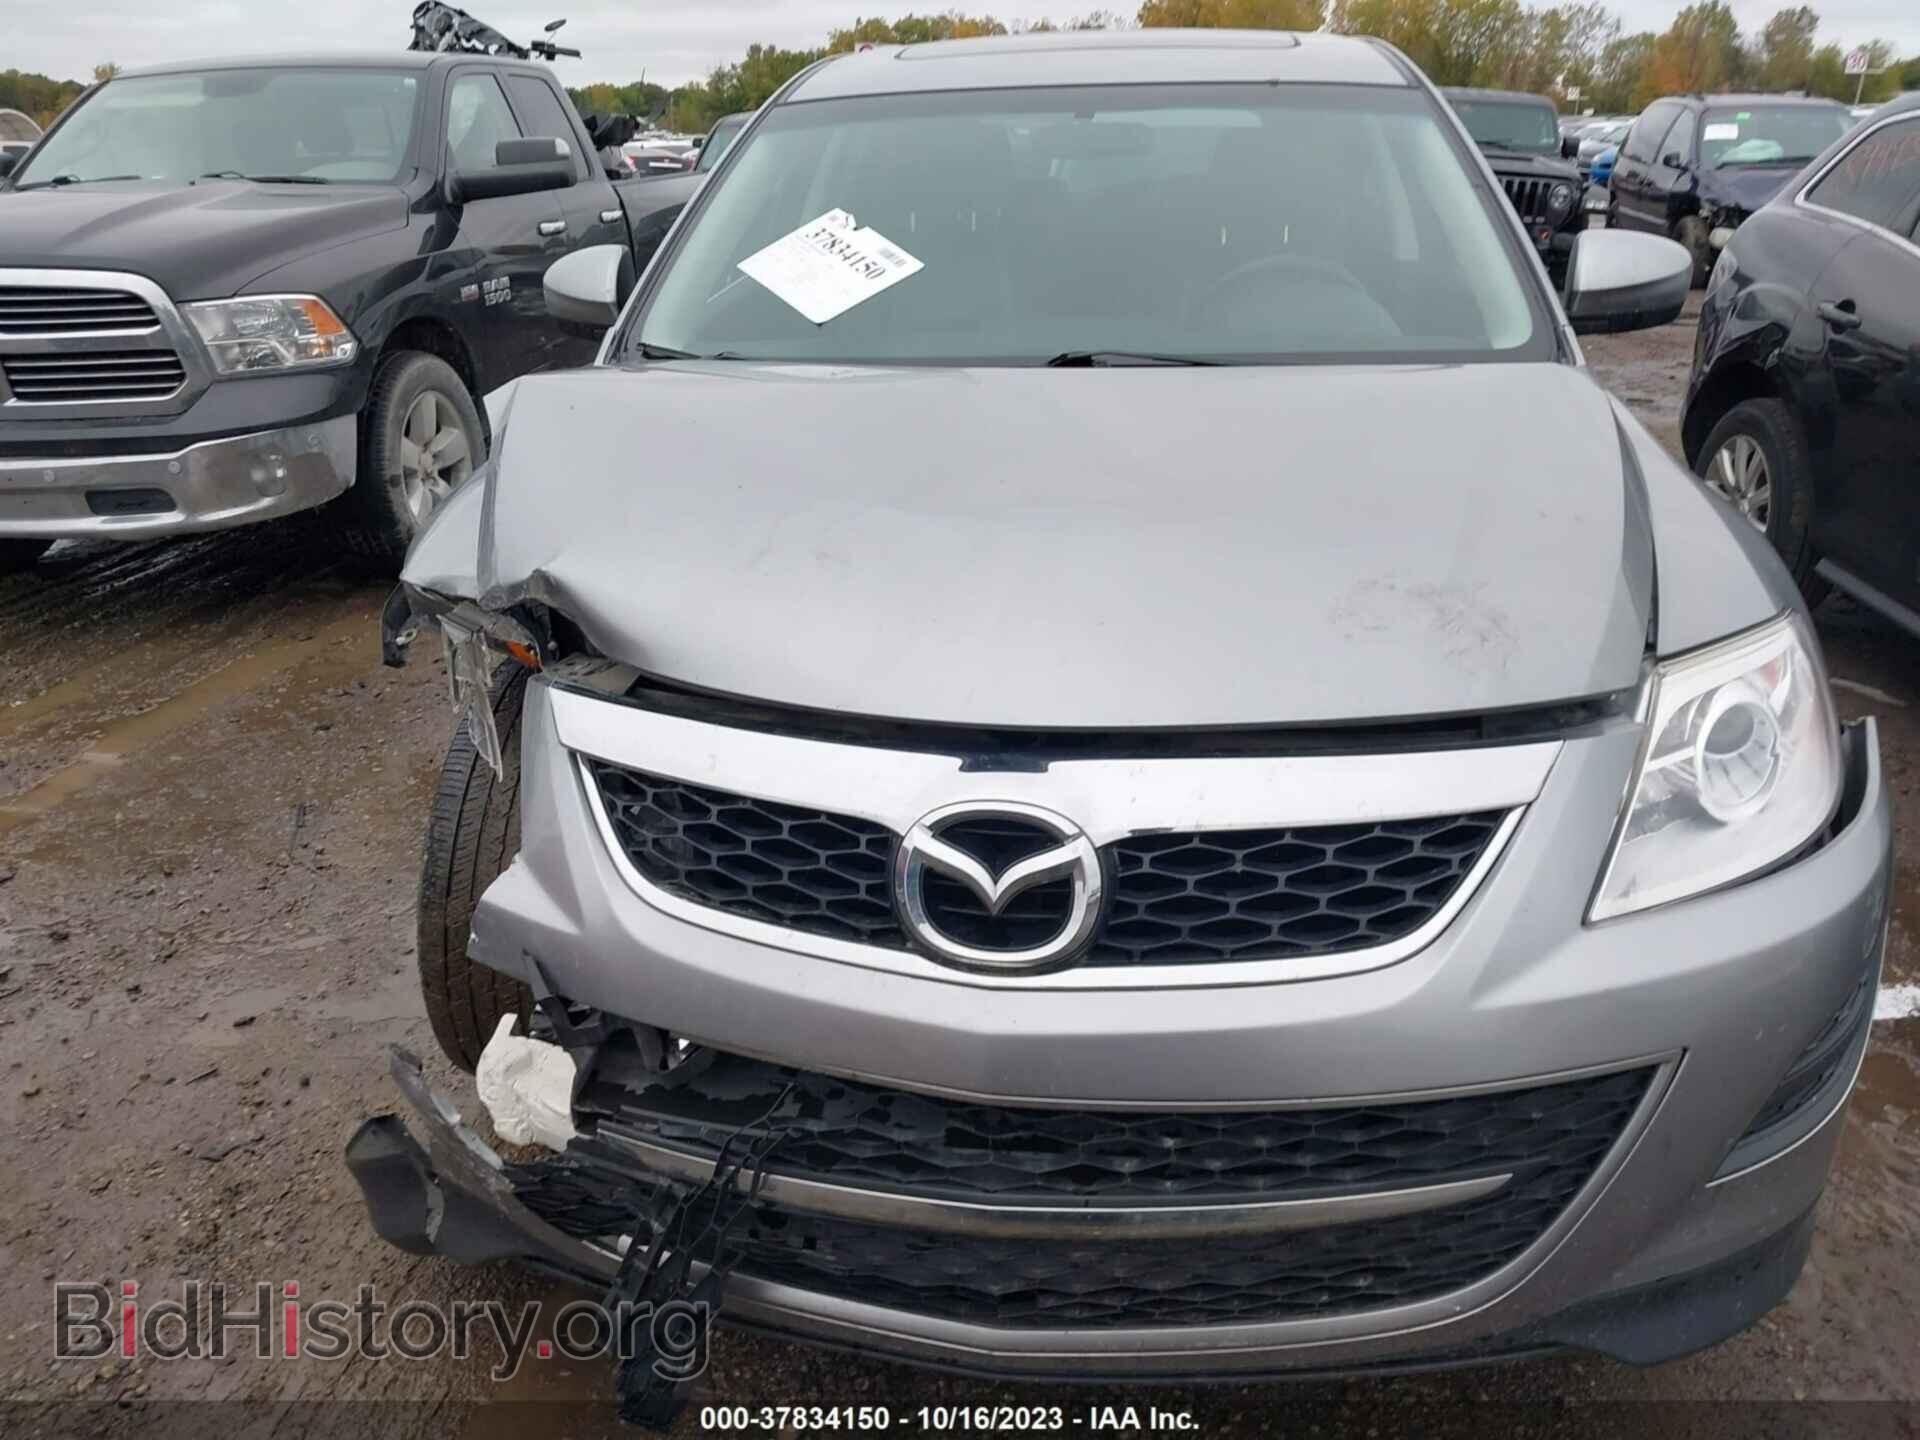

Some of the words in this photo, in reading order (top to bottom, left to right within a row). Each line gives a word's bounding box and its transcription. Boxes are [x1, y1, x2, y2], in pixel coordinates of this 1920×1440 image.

[805, 226, 887, 281] 37834150
[482, 275, 510, 292] RAM
[484, 288, 512, 306] 1500
